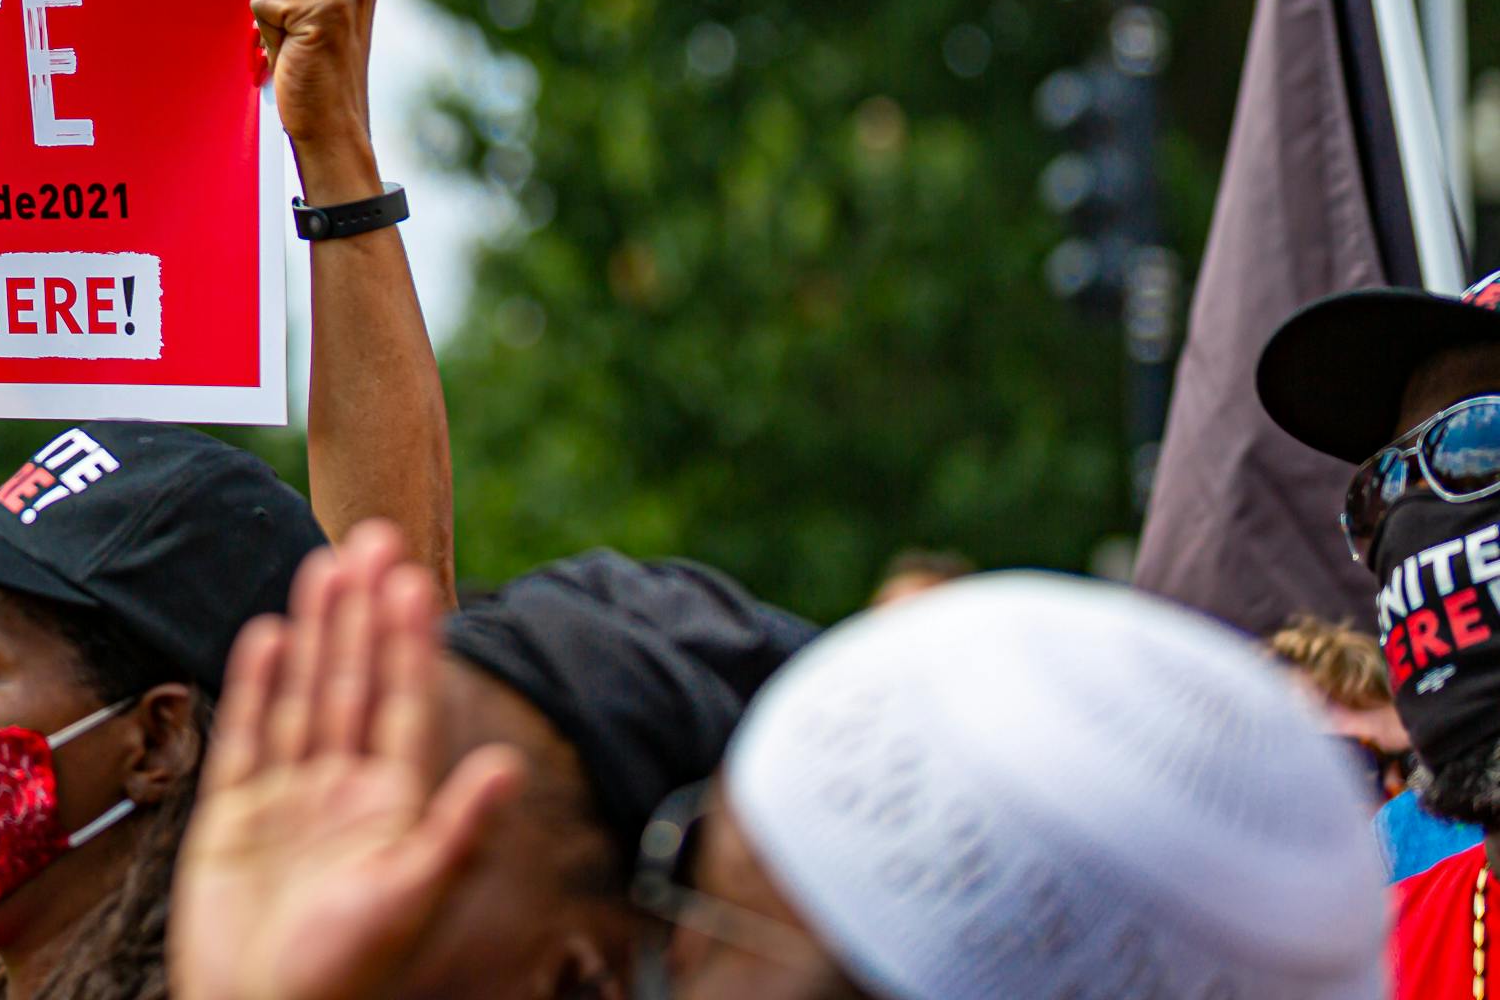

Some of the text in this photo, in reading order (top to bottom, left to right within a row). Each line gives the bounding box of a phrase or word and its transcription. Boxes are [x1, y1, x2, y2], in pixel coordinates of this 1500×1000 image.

[33, 427, 120, 494] ITE
[1377, 524, 1500, 640] NITE
[1384, 578, 1500, 696] ERE
